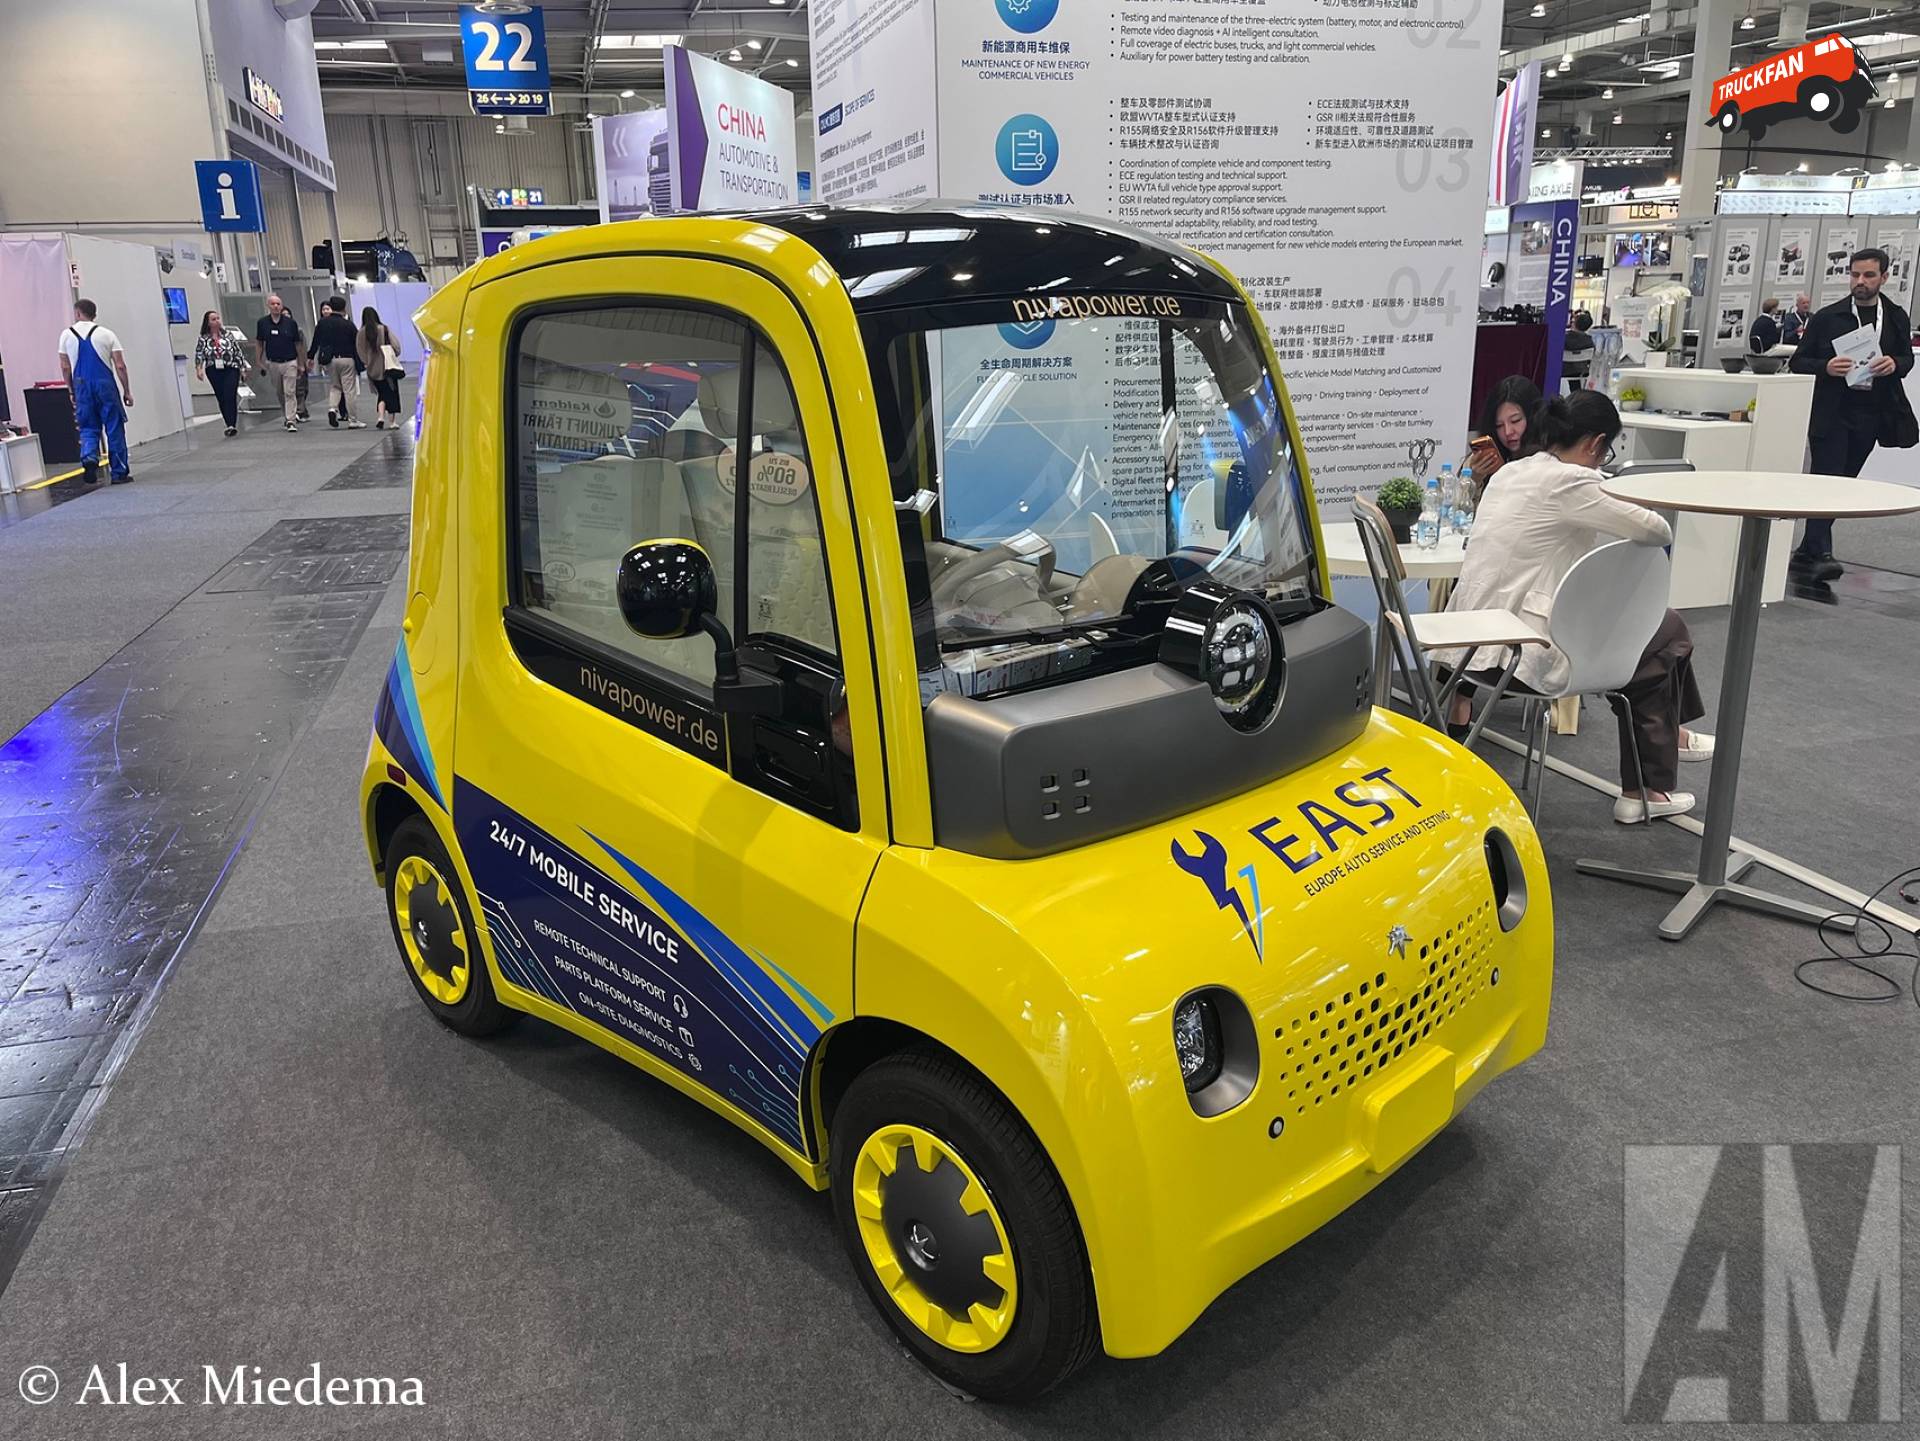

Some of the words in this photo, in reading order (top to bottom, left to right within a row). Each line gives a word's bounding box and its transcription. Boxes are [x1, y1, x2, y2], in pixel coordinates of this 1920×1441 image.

[1121, 12, 1149, 24] Testing
[1151, 12, 1166, 22] and
[1168, 14, 1219, 23] maintenance
[1221, 15, 1229, 24] of
[1231, 15, 1243, 24] the
[1245, 16, 1296, 25] three-electric
[1298, 17, 1324, 27] system
[1326, 16, 1357, 28] (battery,
[1359, 18, 1381, 27] motor,
[1384, 18, 1398, 27] and
[1400, 19, 1434, 28] electronic
[1121, 26, 1151, 35] Remote
[1154, 27, 1175, 36] video
[1177, 27, 1214, 39] diagnosis
[1222, 28, 1230, 36] AI
[1232, 28, 1270, 39] intelligent
[471, 21, 537, 71] 22
[982, 39, 1070, 54] 新能源商用车维保
[1121, 39, 1134, 48] Full
[1136, 40, 1172, 51] coverage
[1174, 40, 1182, 48] of
[1184, 40, 1212, 49] electric
[1214, 40, 1239, 50] buses,
[1240, 41, 1265, 50] trucks,
[1267, 42, 1282, 50] and
[1283, 41, 1300, 53] light
[1302, 42, 1345, 51] commercial
[961, 59, 1021, 69] MAINTENANCE
[1024, 60, 1035, 69] OF
[1037, 60, 1056, 69] NEW
[1058, 61, 1090, 70] ENERGY
[1120, 52, 1153, 63] Auxiliary
[1156, 52, 1166, 61] for
[1169, 54, 1193, 64] power
[1195, 52, 1222, 64] battery
[1225, 54, 1250, 64] testing
[1253, 54, 1268, 62] and
[979, 71, 1033, 80] COMMERCIAL
[1036, 72, 1074, 81] VEHICLES
[476, 93, 489, 104] 26
[518, 94, 530, 104] 20
[532, 94, 543, 104] 19
[718, 104, 766, 142] CHINA
[719, 143, 771, 172] AUTOMOTIVE
[773, 156, 778, 173] &
[1119, 159, 1168, 168] Coordination
[1171, 160, 1179, 168] of
[1181, 160, 1216, 170] complete
[1218, 160, 1244, 168] vehicle
[1245, 160, 1259, 168] and
[1261, 160, 1304, 171] component
[1396, 127, 1470, 193] 03
[1120, 171, 1135, 180] ECE
[1137, 171, 1176, 182] regulation
[1178, 172, 1204, 182] testing
[1205, 171, 1220, 179] and
[1222, 171, 1255, 179] technical
[720, 170, 788, 200] TRANSPORTATION
[1119, 184, 1130, 192] EU
[1132, 184, 1156, 192] WVTA
[1157, 183, 1169, 192] full
[1171, 183, 1198, 192] vehicle
[1200, 184, 1216, 195] type
[1218, 183, 1251, 195] approval
[529, 191, 542, 203] 21
[1119, 207, 1139, 216] R155
[1141, 207, 1172, 216] network
[1173, 208, 1202, 218] security
[1204, 207, 1219, 215] and
[1221, 207, 1240, 215] R156
[1241, 206, 1274, 214] software
[1276, 205, 1306, 216] upgrade
[1308, 206, 1356, 216] management
[1550, 218, 1572, 306] CHINA
[1386, 266, 1462, 328] 04
[980, 356, 1072, 370] 全生命周期解决方案
[1039, 372, 1078, 381] SOLUTION
[1304, 370, 1329, 379] Vehicle
[1330, 368, 1352, 377] Model
[1354, 367, 1385, 377] Matching
[1402, 365, 1442, 374] Customized
[580, 666, 719, 751] nivapower.de
[1247, 767, 1422, 874] EAST
[1304, 865, 1345, 896] EUROPE
[1345, 852, 1371, 873] AUTO
[1369, 834, 1403, 858] SERVICE
[1404, 825, 1421, 841] AND
[1419, 810, 1451, 831] TESTING
[490, 820, 525, 857] 24/7
[530, 846, 594, 906] MOBILE
[598, 894, 679, 964] SERVICE
[534, 920, 569, 949] REMOTE
[571, 939, 621, 977] TECHNICAL
[622, 965, 666, 1002] SUPPORT
[554, 955, 582, 979] PARTS
[584, 969, 632, 1007] PLATFORM
[633, 997, 674, 1033] SERVICE
[578, 992, 617, 1021] ON-SITE
[617, 1013, 683, 1059] DIAGNOSTICS
